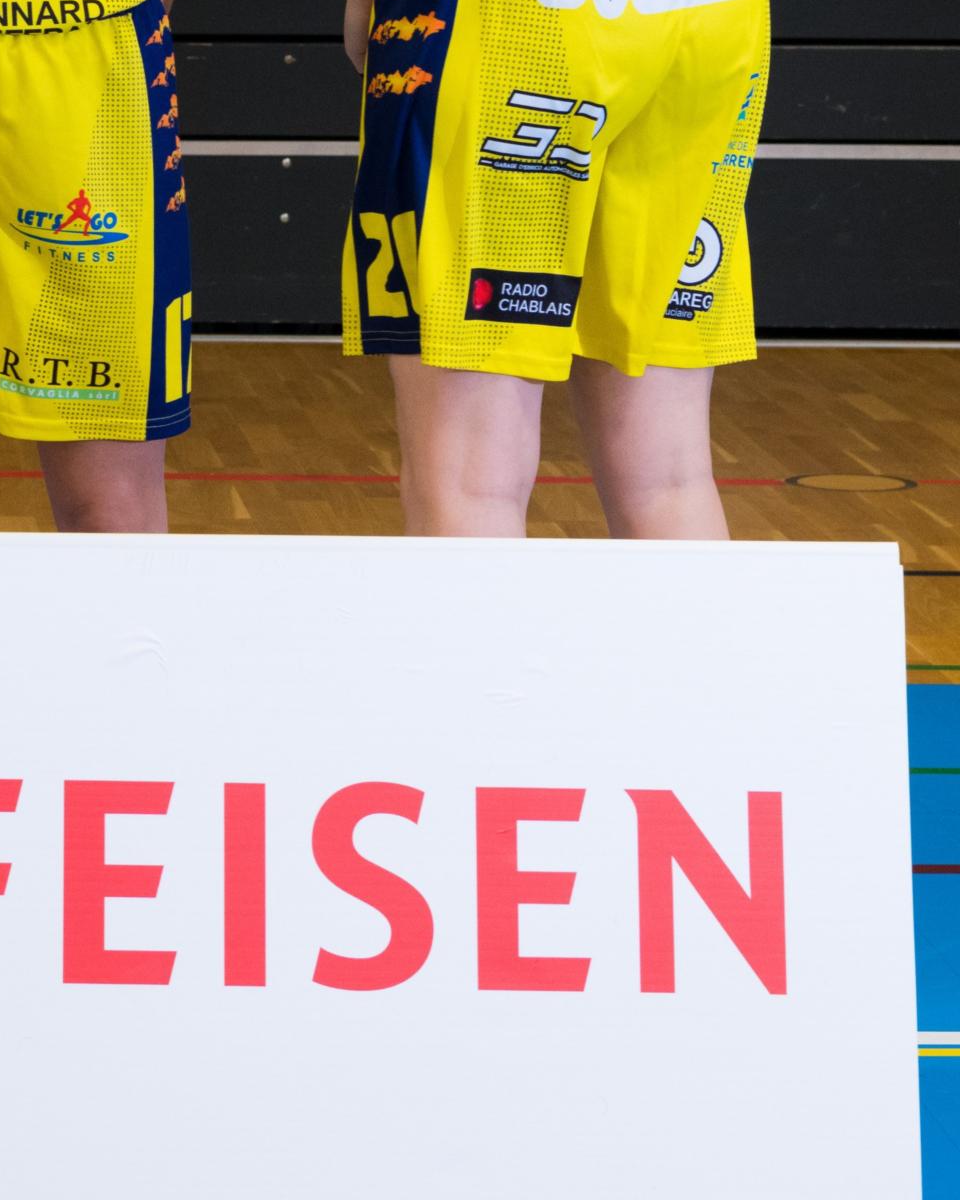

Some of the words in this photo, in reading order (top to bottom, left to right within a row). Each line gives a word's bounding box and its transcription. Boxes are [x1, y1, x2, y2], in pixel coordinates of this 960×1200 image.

[16, 208, 64, 231] LET'S
[90, 212, 118, 231] GO
[23, 241, 116, 262] FITNESS
[501, 282, 548, 297] RADIO
[498, 298, 572, 316] CHABLAIS
[0, 380, 80, 399] CORVAGLIA
